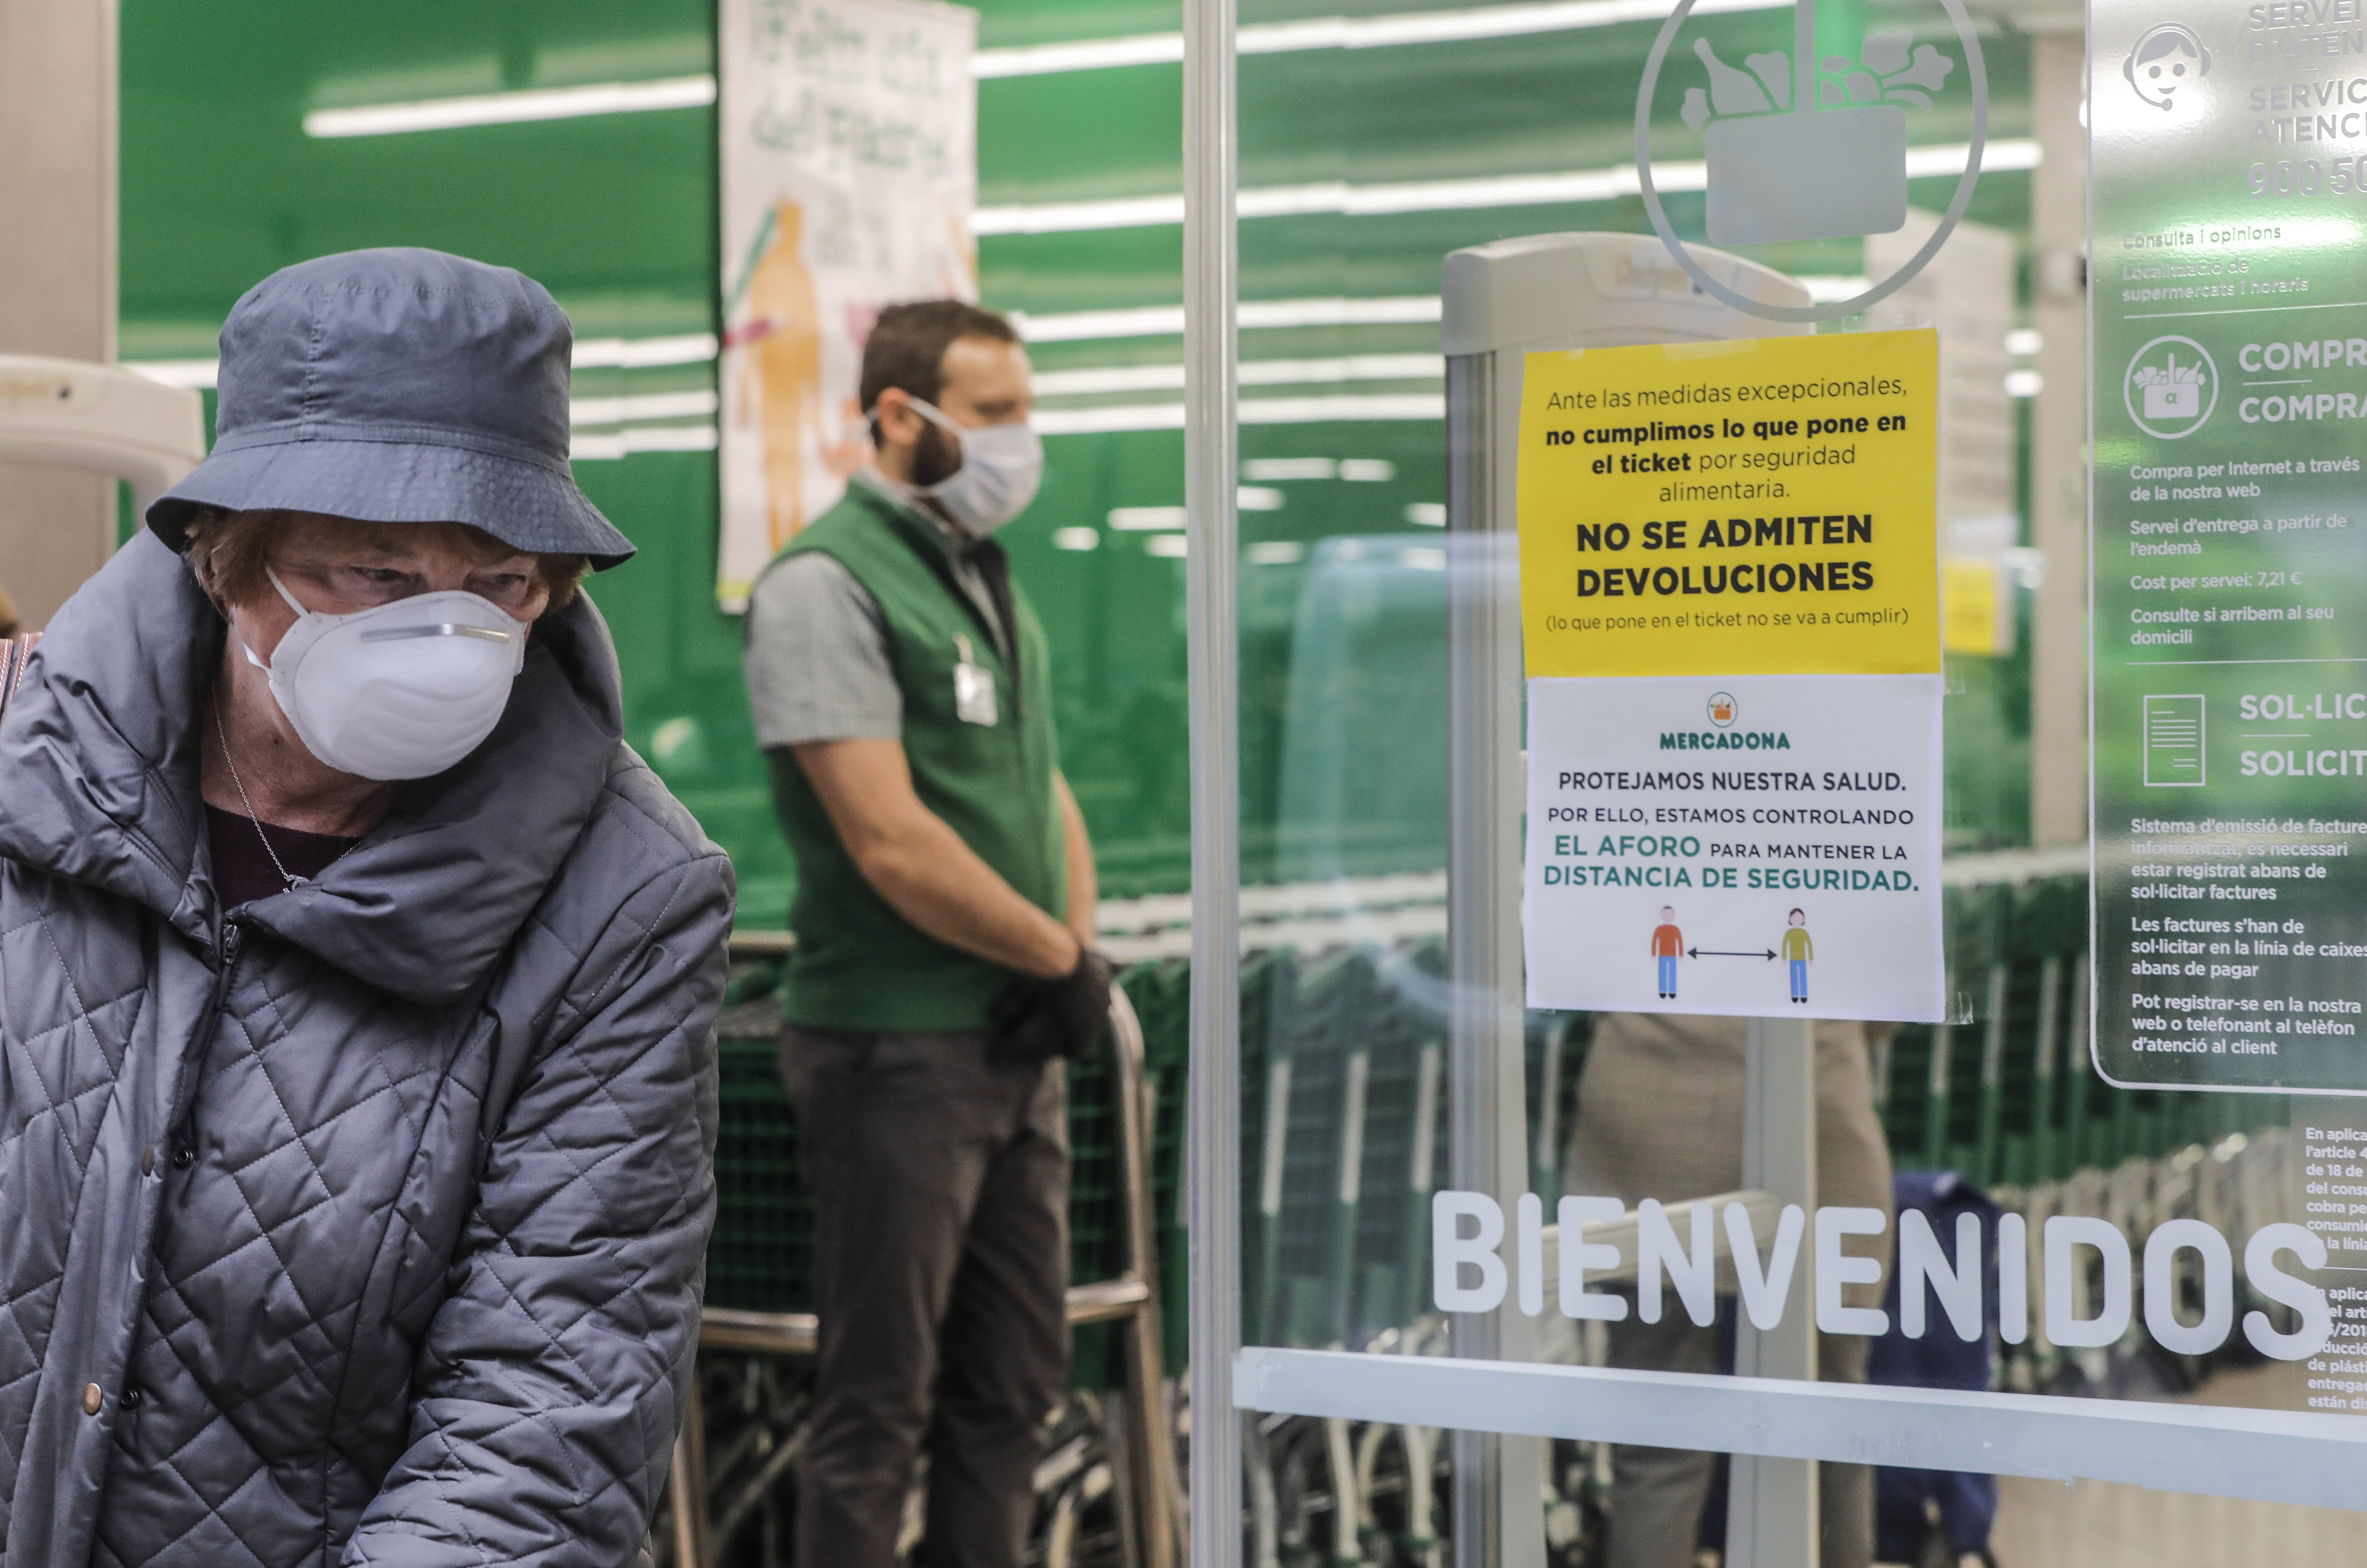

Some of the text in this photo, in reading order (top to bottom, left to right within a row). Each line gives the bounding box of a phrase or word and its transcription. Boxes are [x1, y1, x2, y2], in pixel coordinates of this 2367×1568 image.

[2250, 29, 2367, 64] D'ATEN
[2250, 77, 2367, 112] SERVIC
[2248, 158, 2321, 199] 900
[2124, 231, 2194, 249] Consulta
[2210, 226, 2281, 245] opinions
[2123, 259, 2250, 280] Localització de
[2122, 278, 2309, 303] supermercats i horaris
[2239, 338, 2367, 371] COMPR
[1547, 376, 1906, 410] Ante las medidas excepcionales,
[1547, 416, 1905, 446] no cumplimos lo que pone en
[1592, 444, 1855, 474] el ticket por seguridad
[2130, 456, 2360, 480] Compra per Internet a través
[1660, 479, 1790, 502] alimentaria.
[2130, 482, 2261, 501] de la nostra web
[1577, 515, 1871, 551] NO SE ADMITEN
[2131, 514, 2347, 534] Servei d'entrega a partir de
[2131, 540, 2202, 556] l'endemà
[1578, 562, 1873, 596] DEVOLUCIONES
[2131, 571, 2301, 591] Cost per servei: 7,21 €
[1546, 608, 1908, 632] (lo que pone en el ticket no se va a cumplir)
[2131, 605, 2334, 623] Consulte si arribem al seu
[2131, 629, 2192, 645] domicili
[1660, 732, 1790, 749] MERCADONA
[2241, 750, 2367, 776] SOLICIT
[1560, 772, 1905, 791] PROTEJAMOS NUESTRA SALUD.
[1549, 808, 1913, 824] POR ELLO, ESTAMOS CONTROLANDO
[2131, 818, 2367, 834] Sistema d'emissió de facture
[1556, 835, 1907, 859] EL AFORO PARA MANTENER LA
[2270, 842, 2348, 857] necessari
[1545, 866, 1918, 891] DISTANCIA DE SEGURIDAD.
[2132, 862, 2326, 879] estar registrat abans de
[2209, 884, 2277, 900] factures
[2132, 917, 2304, 934] Les factures s'han de
[2210, 943, 2230, 954] en
[2235, 940, 2249, 954] la
[2293, 941, 2315, 956] de
[2319, 942, 2367, 957] caixes
[2132, 960, 2259, 979] abans de pagar
[2132, 994, 2361, 1013] Pot registrar-se en la nostra
[2132, 1016, 2355, 1035] web o telefonant al telèfon
[2132, 1036, 2277, 1054] d'atenció al client
[2306, 1128, 2367, 1142] En aplica
[2306, 1145, 2356, 1159] l'article
[2306, 1164, 2363, 1177] de 18 de
[2306, 1182, 2327, 1194] del
[2307, 1200, 2345, 1213] cobra
[2327, 1237, 2339, 1249] la
[1433, 1190, 2332, 1361] BIENVENIDOS
[2308, 1358, 2326, 1371] de
[2308, 1395, 2347, 1408] están
